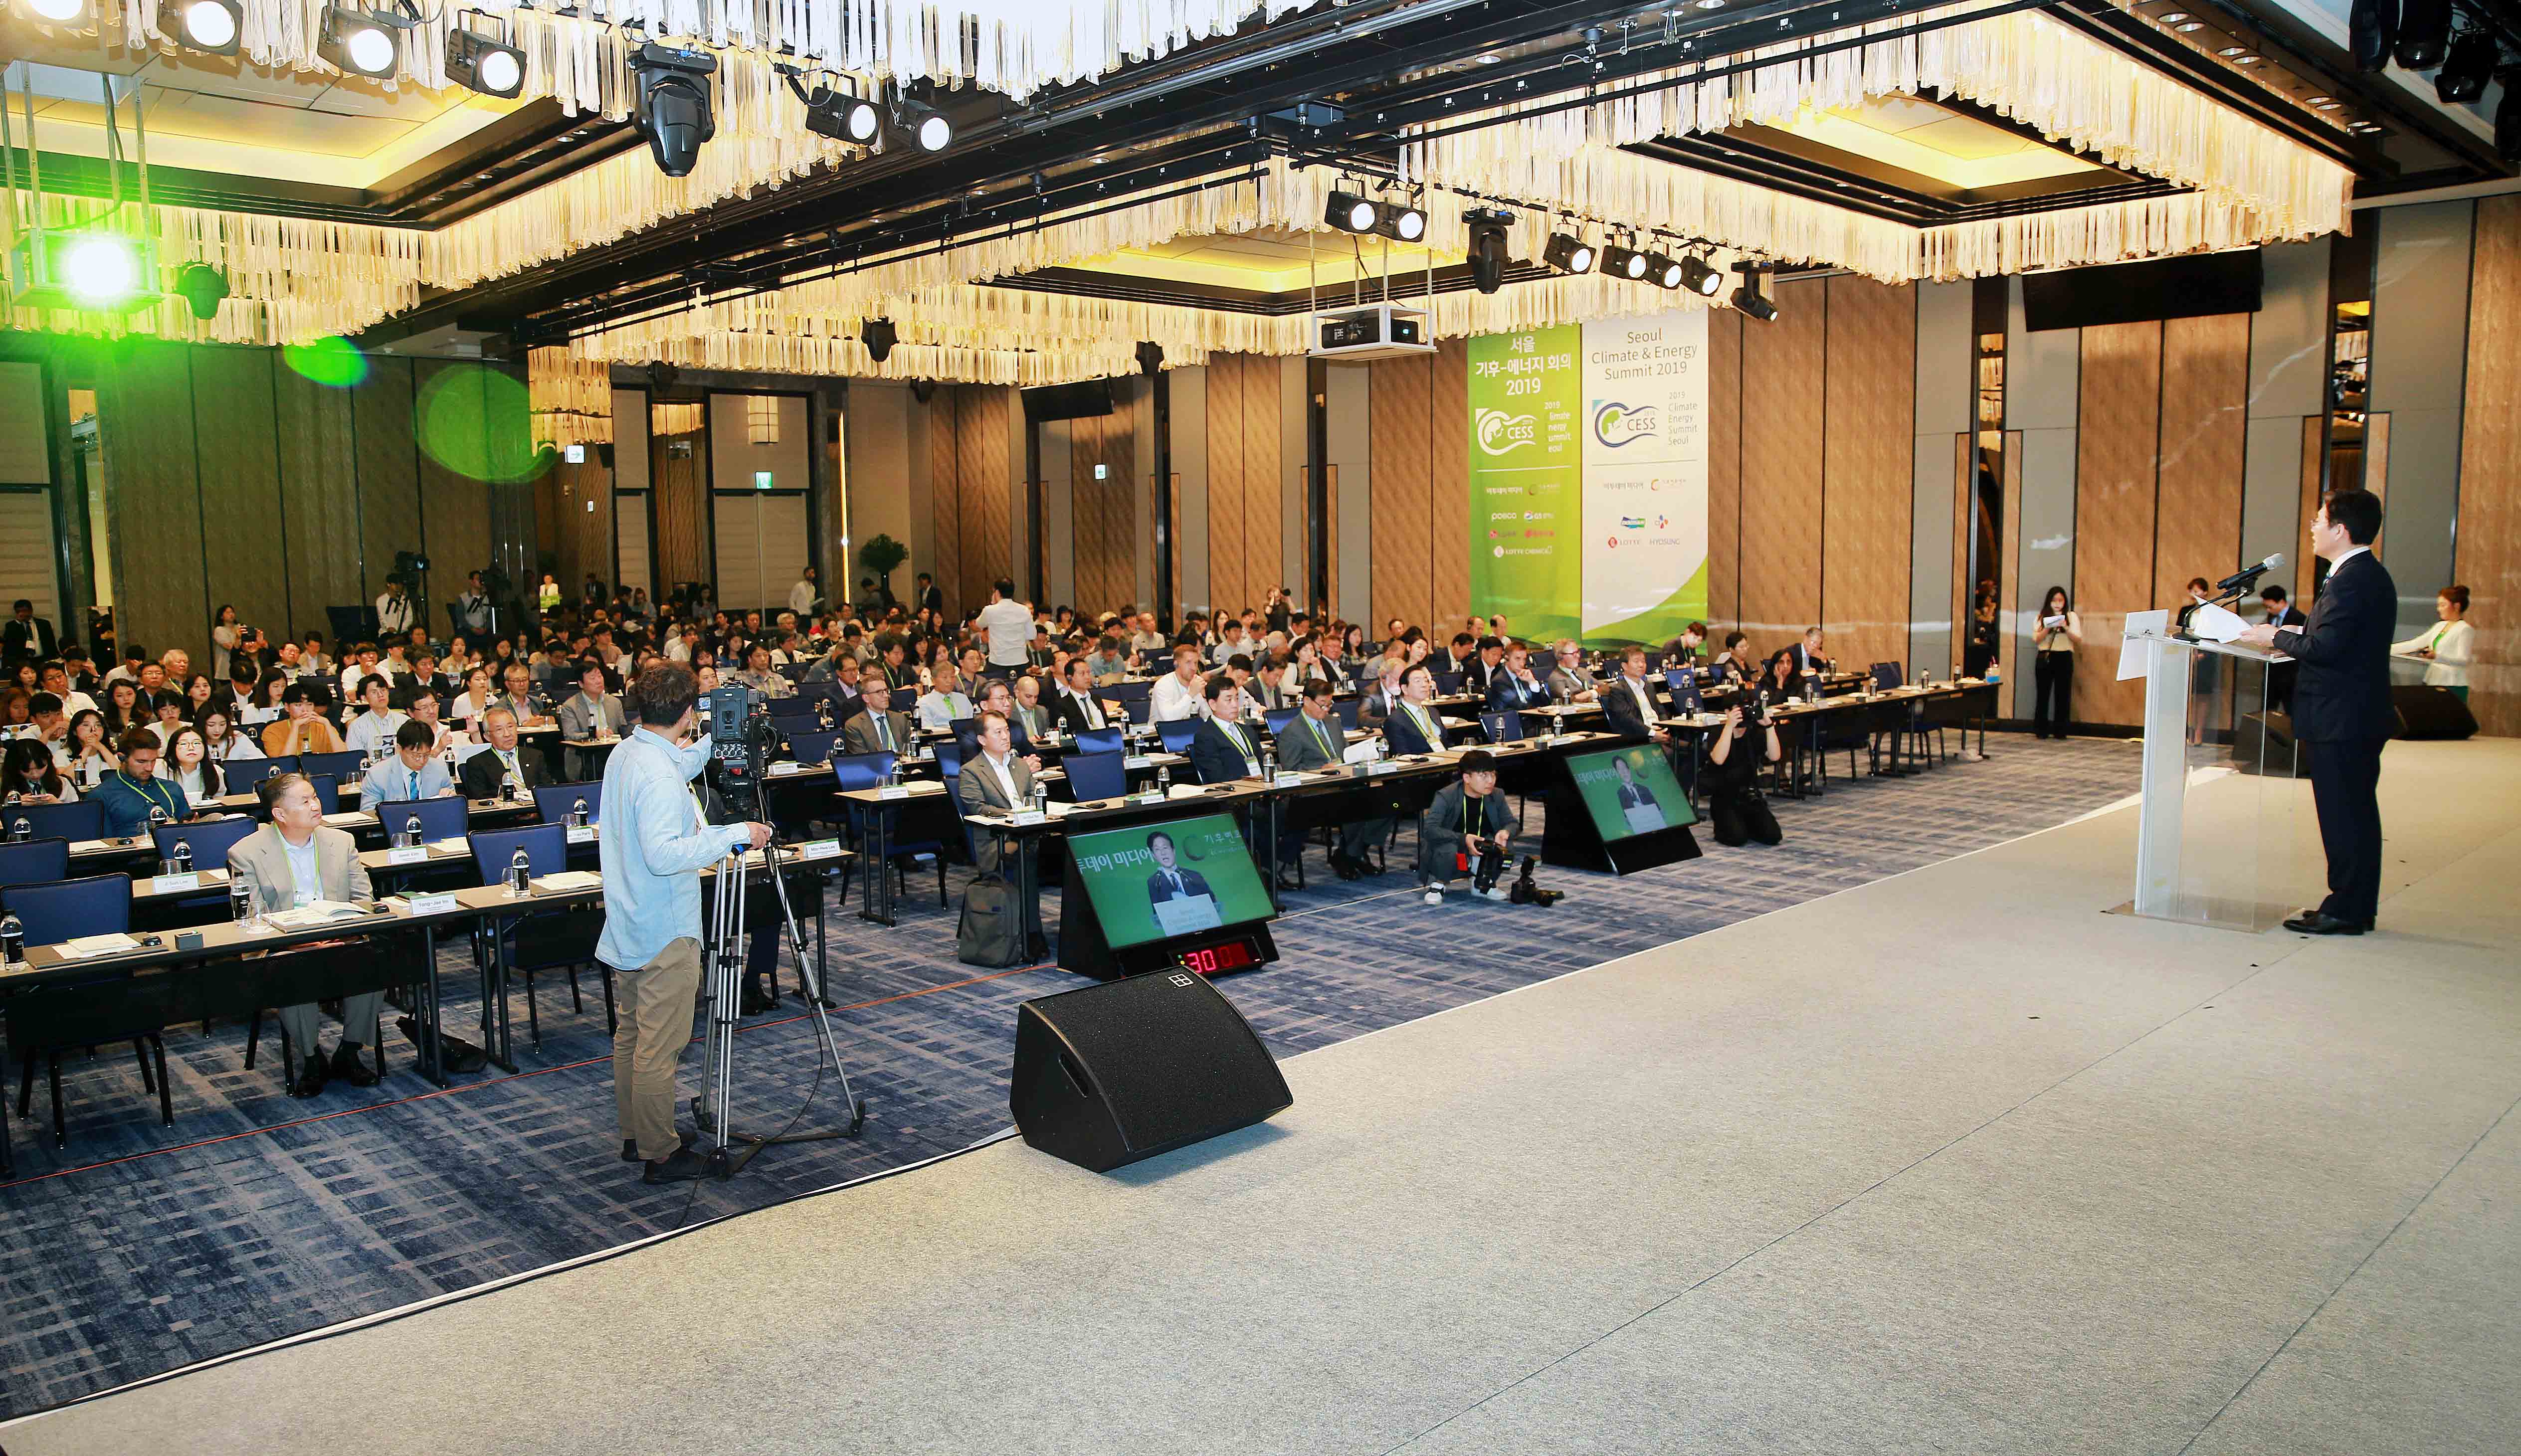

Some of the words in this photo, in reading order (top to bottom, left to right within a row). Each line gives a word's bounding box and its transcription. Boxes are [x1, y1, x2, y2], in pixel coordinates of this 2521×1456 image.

[1627, 327, 1662, 344] Seoul
[1510, 336, 1535, 354] 서울
[1591, 350, 1638, 364] Climate
[1642, 347, 1651, 359] &
[1655, 344, 1698, 359] Energy
[1476, 356, 1544, 378] 기후-에너지
[1548, 353, 1572, 371] 회의
[1604, 364, 1652, 380] Summit
[1656, 361, 1688, 375] 2019
[1506, 377, 1541, 395] 2019
[1669, 391, 1685, 399] 2019
[1544, 401, 1560, 409] 2019
[1668, 402, 1698, 412] Climate
[1627, 417, 1656, 431] CESS
[1668, 414, 1694, 424] Energy
[1507, 425, 1534, 439] CESS
[1668, 424, 1698, 434] Summit
[1668, 435, 1689, 446] Seoul
[1113, 847, 1155, 868] 미디어
